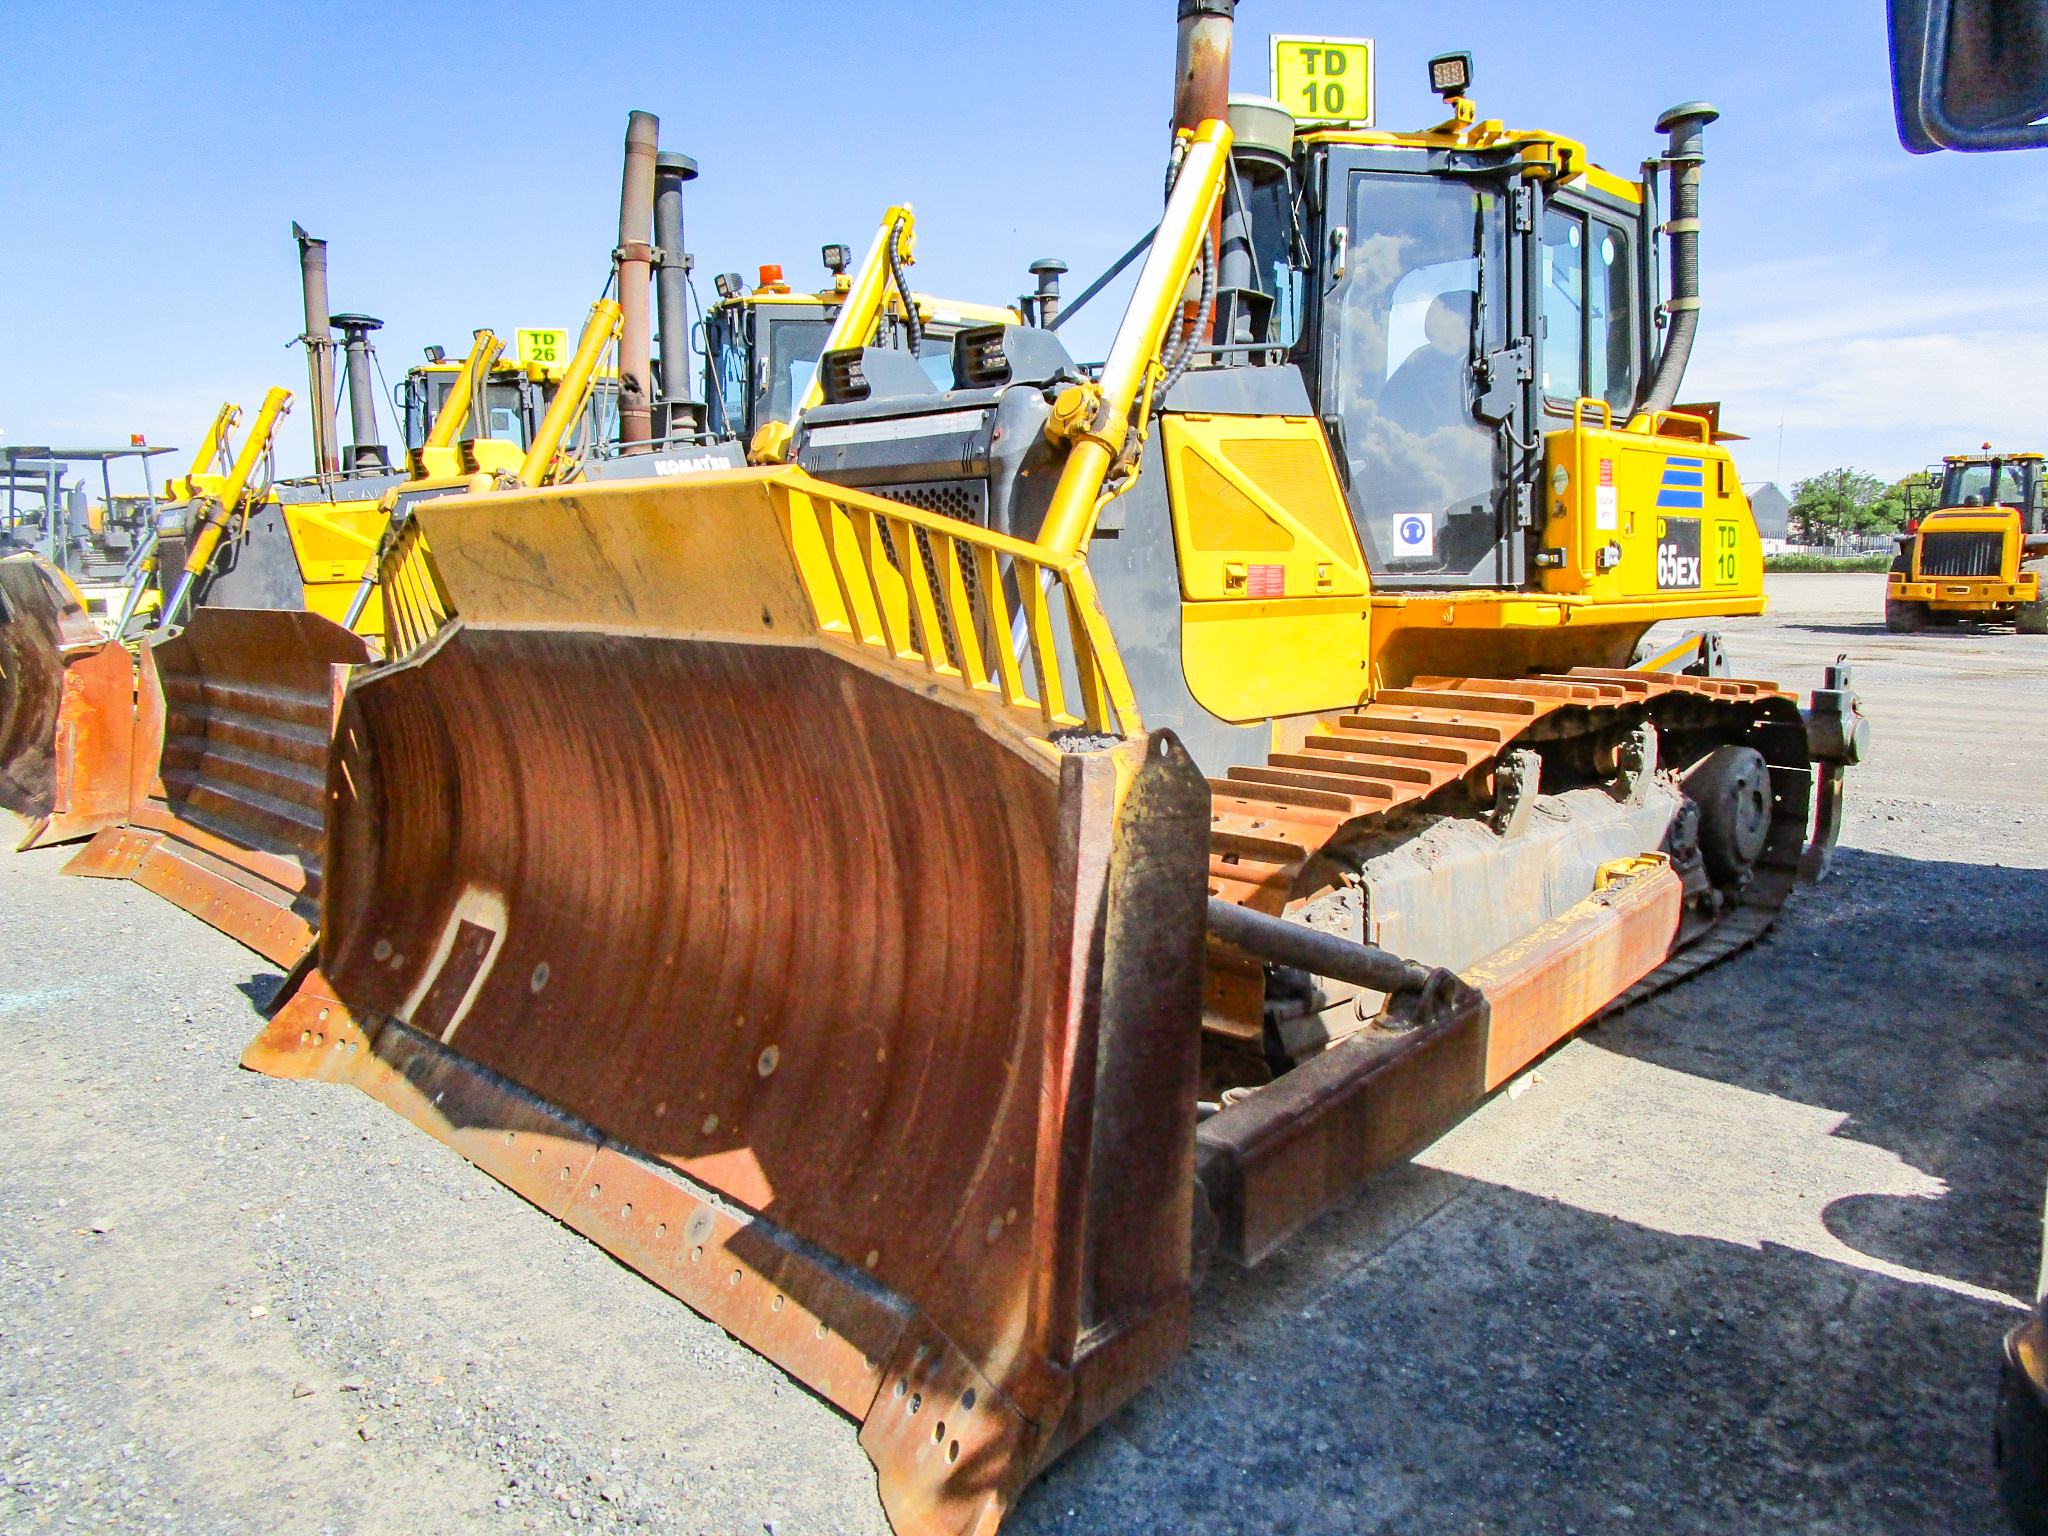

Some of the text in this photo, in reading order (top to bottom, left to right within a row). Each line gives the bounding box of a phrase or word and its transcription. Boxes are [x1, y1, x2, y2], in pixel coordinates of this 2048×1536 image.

[1300, 48, 1346, 75] TD
[1302, 82, 1344, 113] 10
[530, 333, 555, 345] TD
[532, 348, 555, 361] 26
[654, 454, 731, 476] KOMATSU
[1718, 526, 1736, 548] TD
[1658, 543, 1700, 586] 65EX
[1718, 554, 1735, 578] 10
